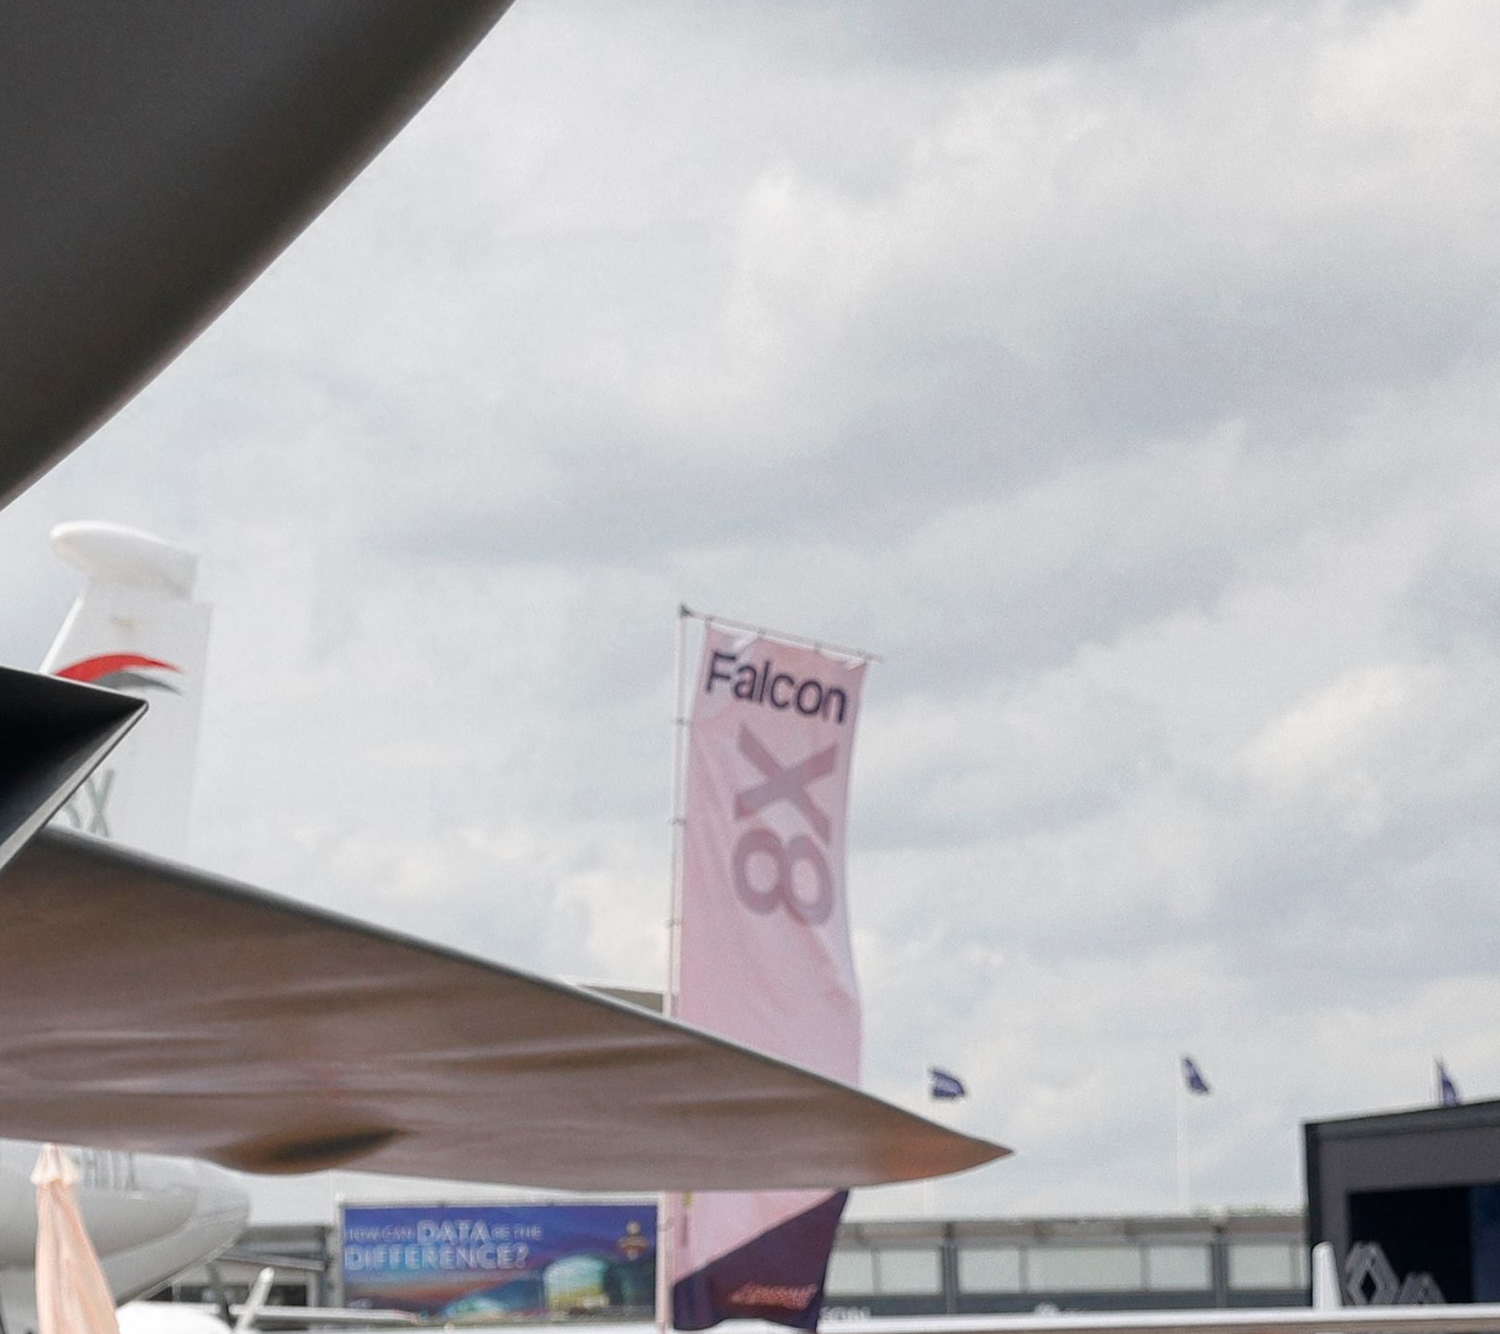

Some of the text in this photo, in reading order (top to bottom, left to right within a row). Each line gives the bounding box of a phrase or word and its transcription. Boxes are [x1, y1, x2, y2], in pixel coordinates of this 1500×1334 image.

[706, 651, 847, 723] Falcon
[416, 1220, 492, 1244] DATA
[344, 1243, 530, 1269] DIFFERENCE?
